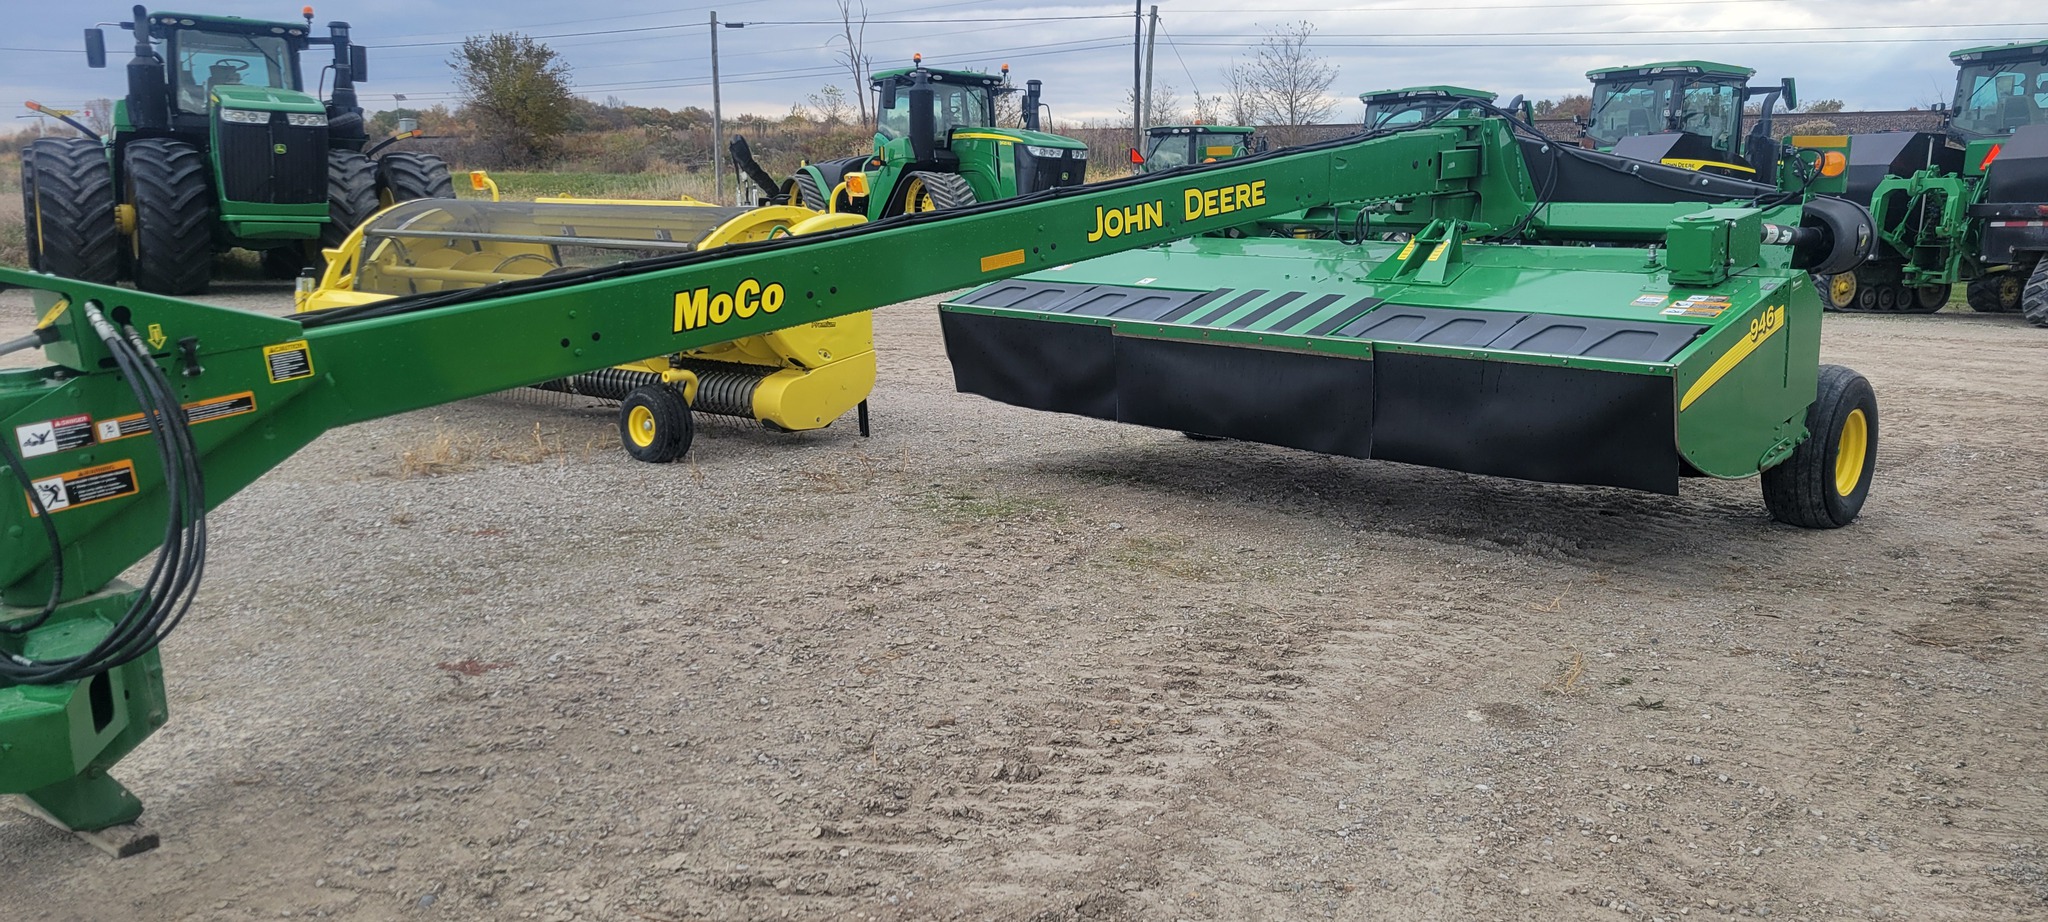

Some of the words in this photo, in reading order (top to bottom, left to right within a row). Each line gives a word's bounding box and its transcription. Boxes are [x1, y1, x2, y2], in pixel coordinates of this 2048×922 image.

[1087, 199, 1163, 242] JOHN
[1184, 180, 1266, 221] DEERE
[672, 278, 785, 333] MoCo
[1750, 305, 1775, 342] 946
